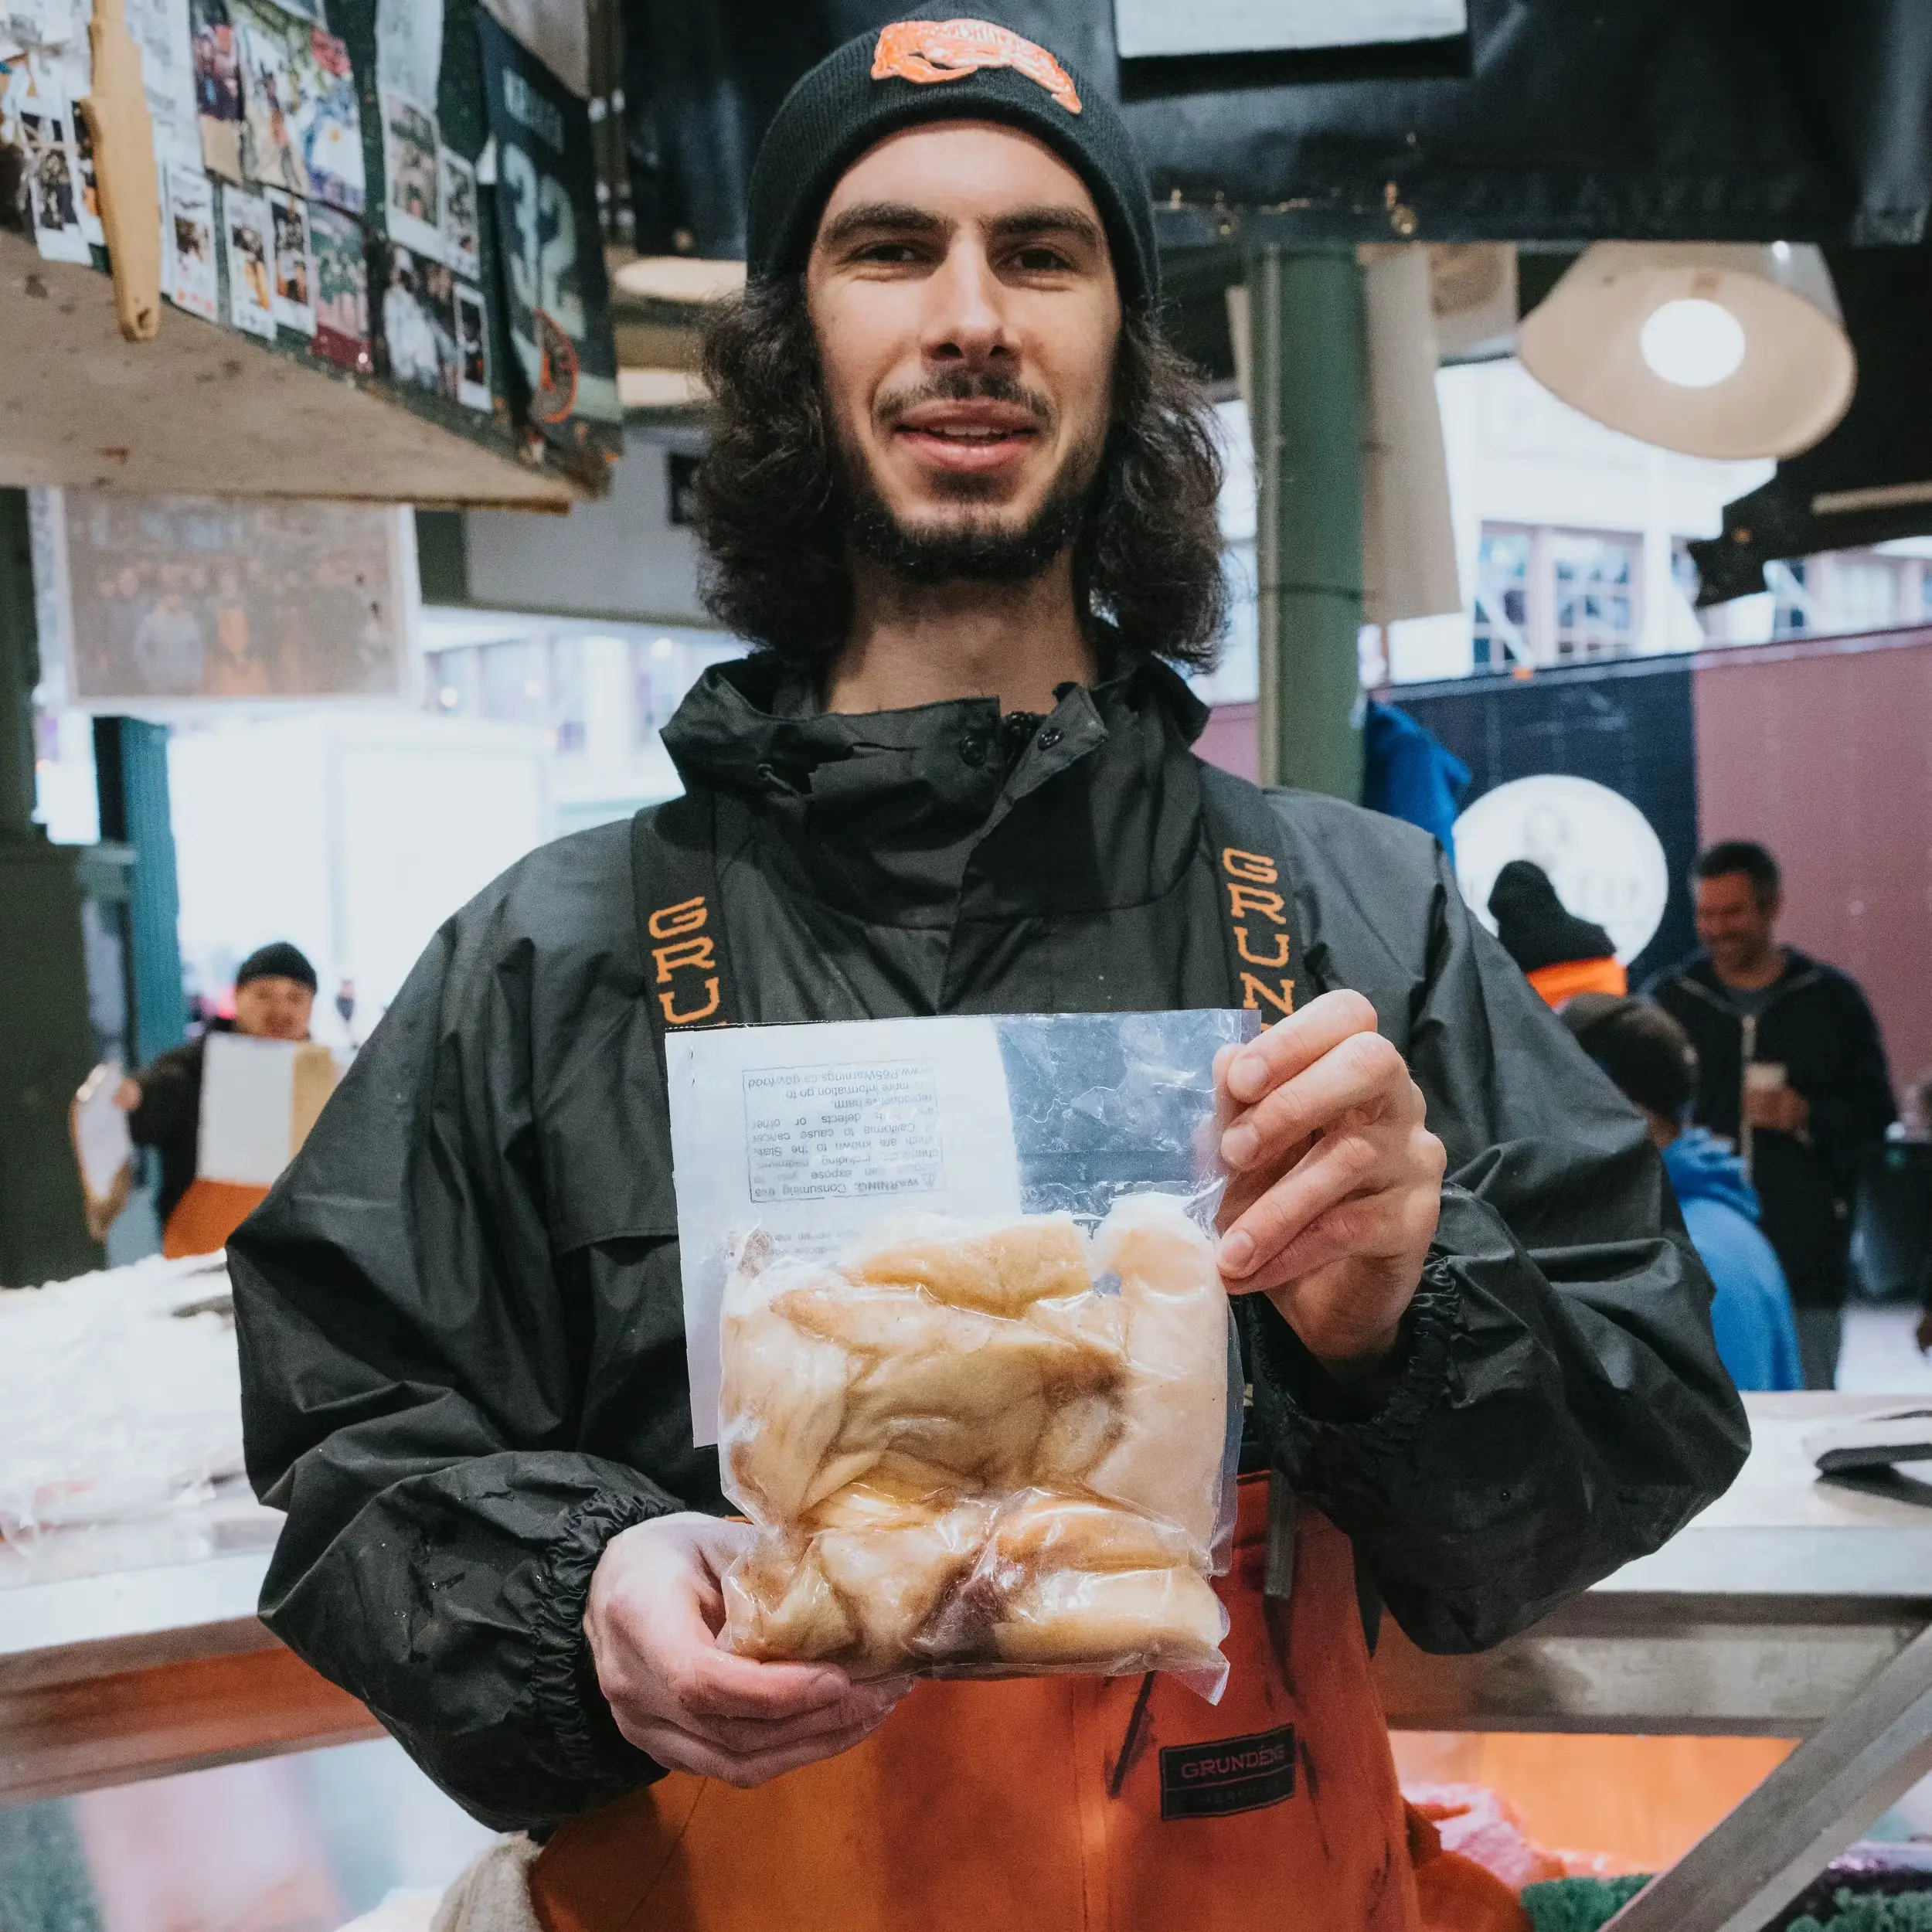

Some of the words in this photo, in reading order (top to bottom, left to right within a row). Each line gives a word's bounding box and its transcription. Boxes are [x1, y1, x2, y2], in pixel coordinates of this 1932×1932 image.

[1223, 847, 1295, 1032] GRUN
[648, 896, 720, 1026] GRU
[800, 1086, 814, 1098] go
[818, 1083, 878, 1097] information
[881, 1082, 909, 1092] more
[785, 1090, 798, 1100] to
[831, 1099, 862, 1111] harm.
[794, 1117, 807, 1127] or
[821, 1112, 861, 1125] defects
[800, 1128, 834, 1139] cause
[844, 1128, 854, 1138] to
[864, 1122, 915, 1134] California
[753, 1132, 791, 1143] cancer
[879, 1138, 897, 1148] are
[816, 1143, 827, 1152] to
[835, 1140, 872, 1150] known
[811, 1167, 852, 1180] expose
[782, 1183, 846, 1196] Consuming
